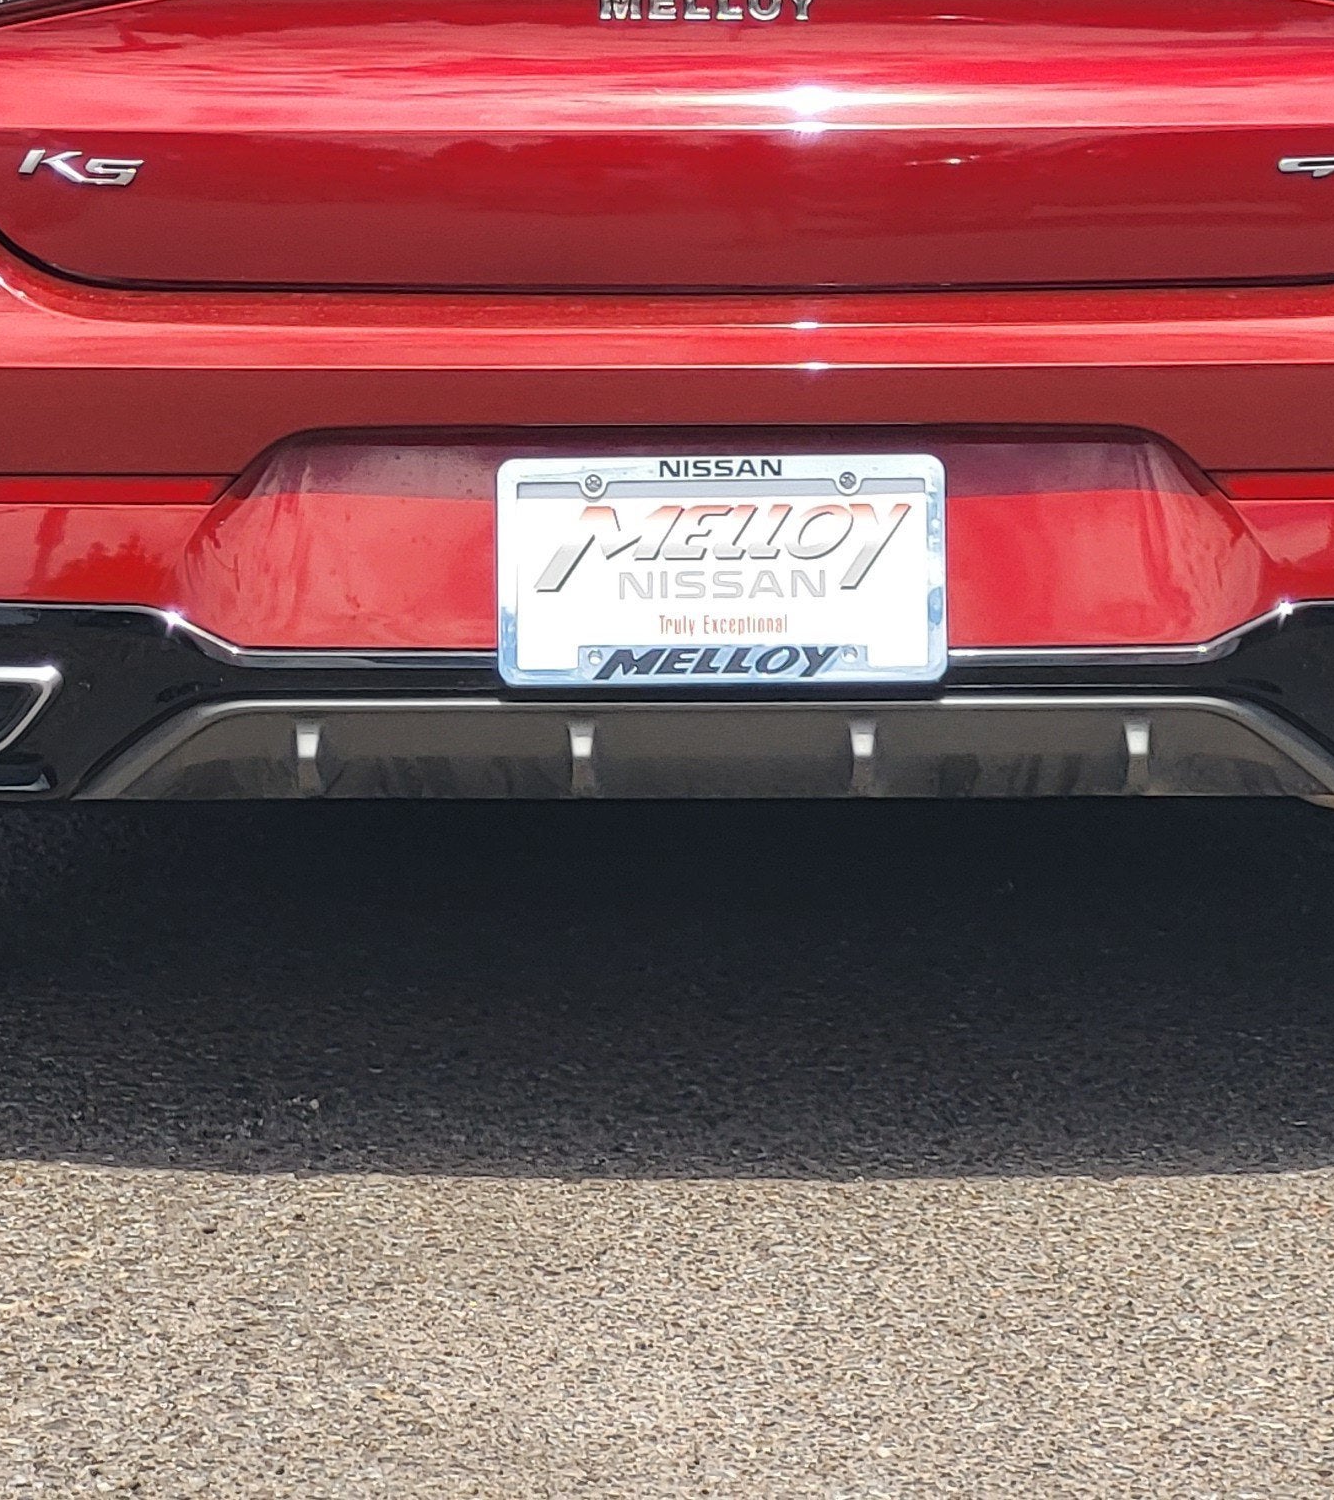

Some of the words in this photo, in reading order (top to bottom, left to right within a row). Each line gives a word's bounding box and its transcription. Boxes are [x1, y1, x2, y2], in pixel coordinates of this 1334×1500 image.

[17, 149, 145, 186] K5
[659, 459, 783, 478] NISSAN
[533, 503, 912, 593] MELLOY
[618, 569, 827, 600] NISSAN
[659, 614, 696, 637] Truly
[703, 614, 788, 636] Exceptional
[592, 645, 839, 681] MELLOY
